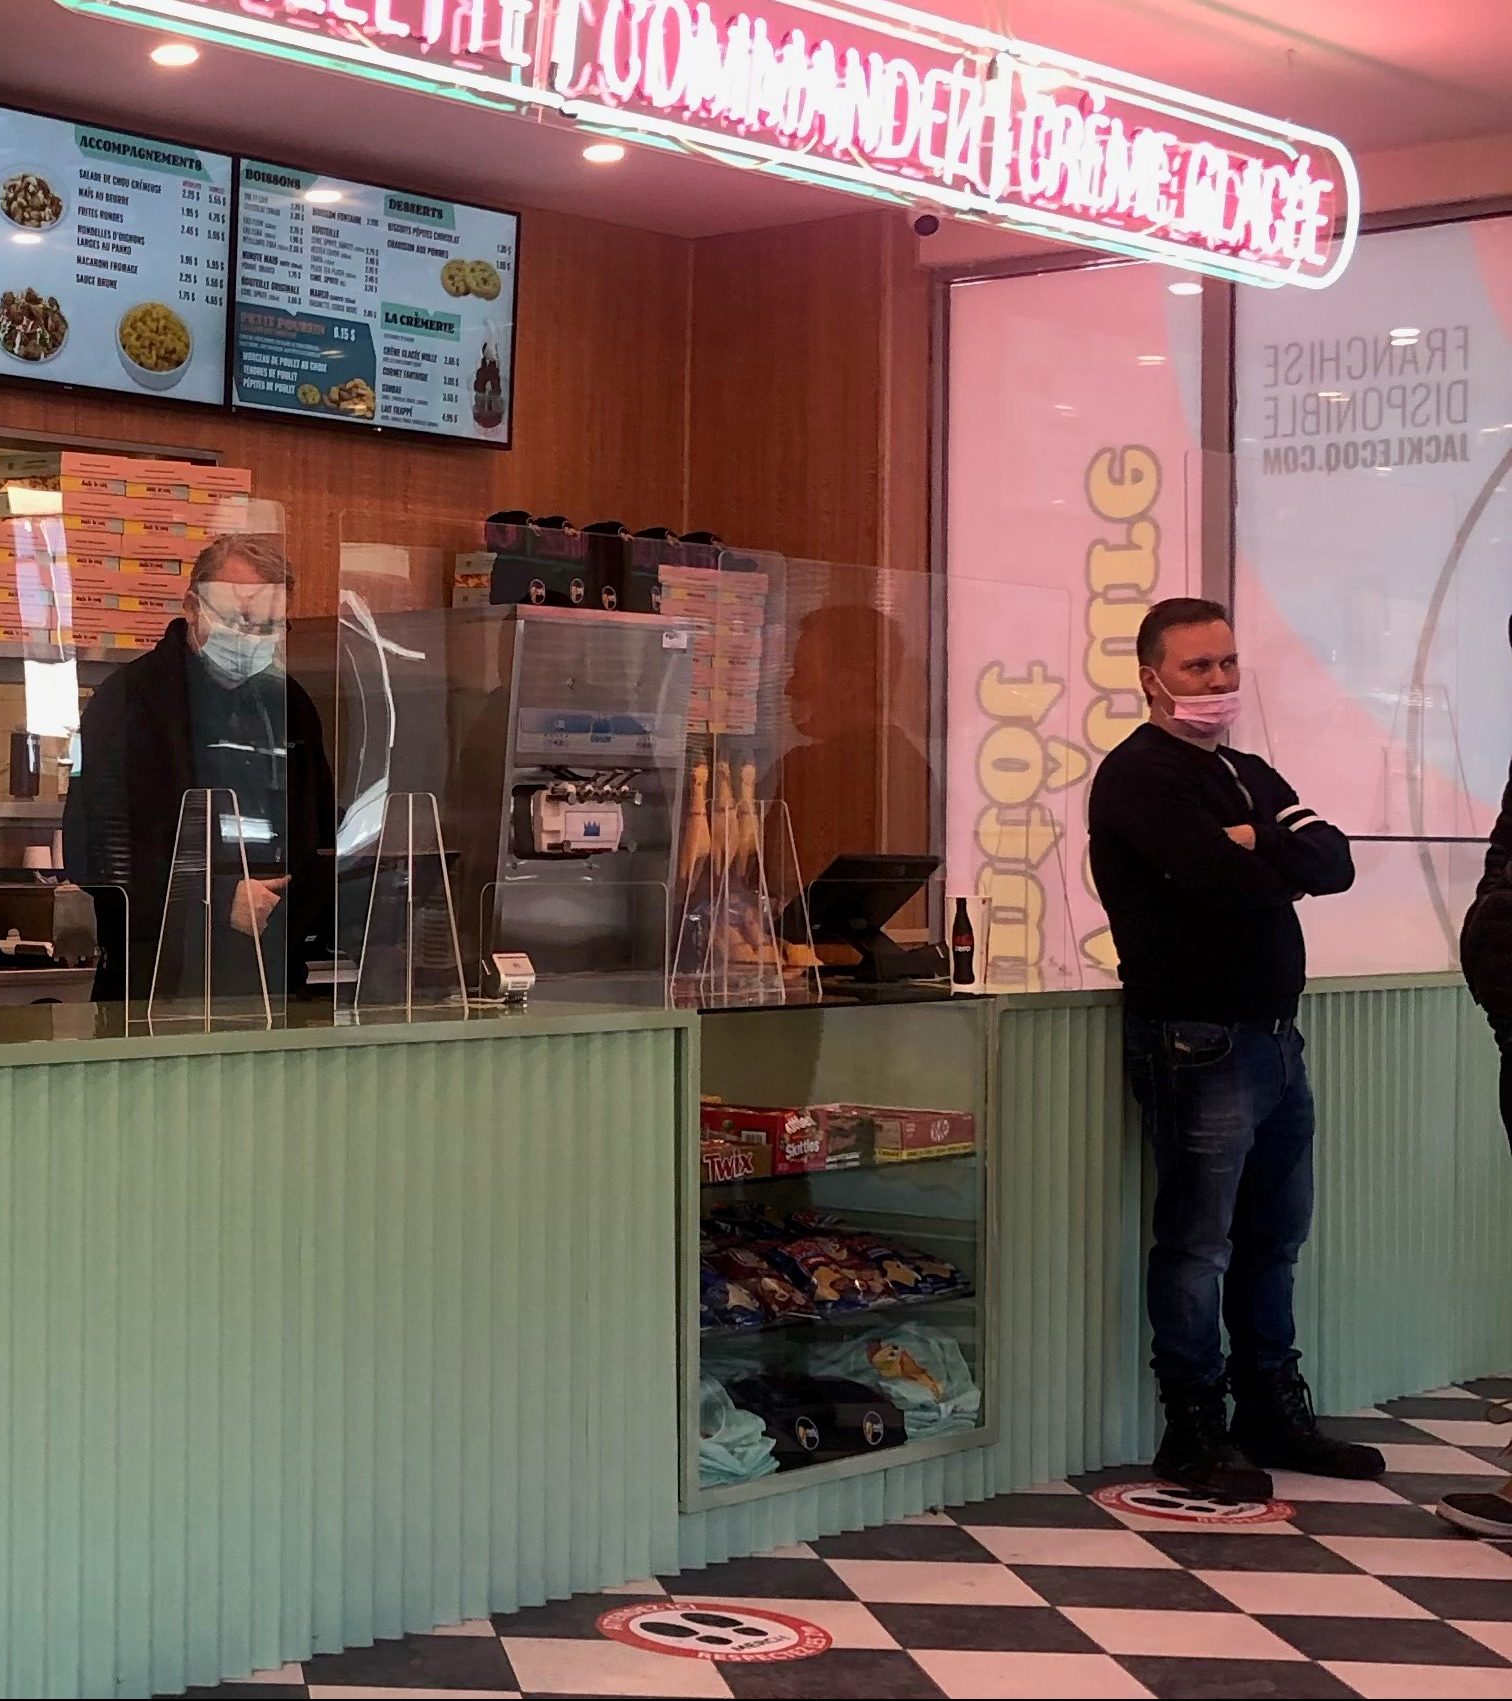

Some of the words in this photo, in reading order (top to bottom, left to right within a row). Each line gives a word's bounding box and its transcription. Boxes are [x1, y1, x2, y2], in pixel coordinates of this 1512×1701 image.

[80, 134, 202, 172] ACCOMPAGNEMENTS
[245, 168, 301, 190] BOISSONS
[389, 199, 444, 219] DESSERTS
[76, 274, 96, 286] SAUCE
[384, 312, 398, 324] LA
[400, 311, 455, 334] CRÈMERIE
[703, 1149, 755, 1182] Twix
